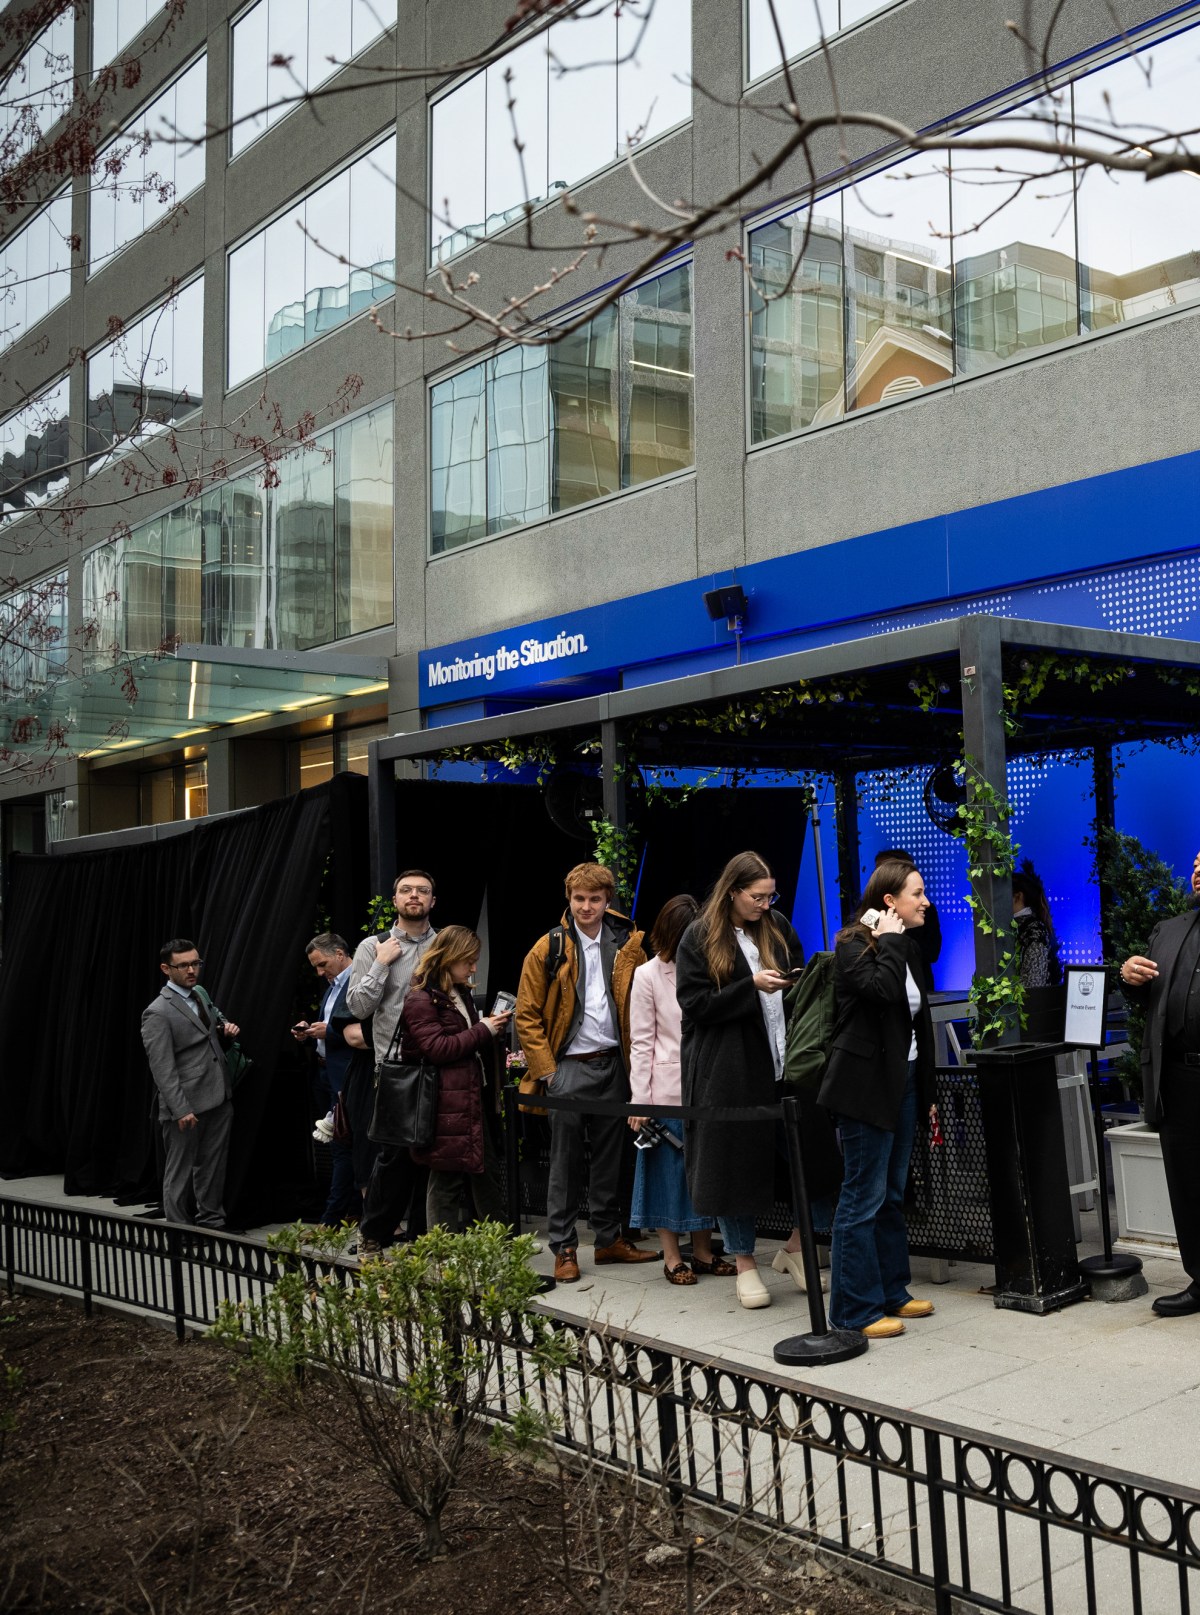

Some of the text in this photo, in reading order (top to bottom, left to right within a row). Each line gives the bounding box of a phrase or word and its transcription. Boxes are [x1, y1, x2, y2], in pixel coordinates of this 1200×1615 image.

[428, 630, 588, 688] Monitoring the Situation.
